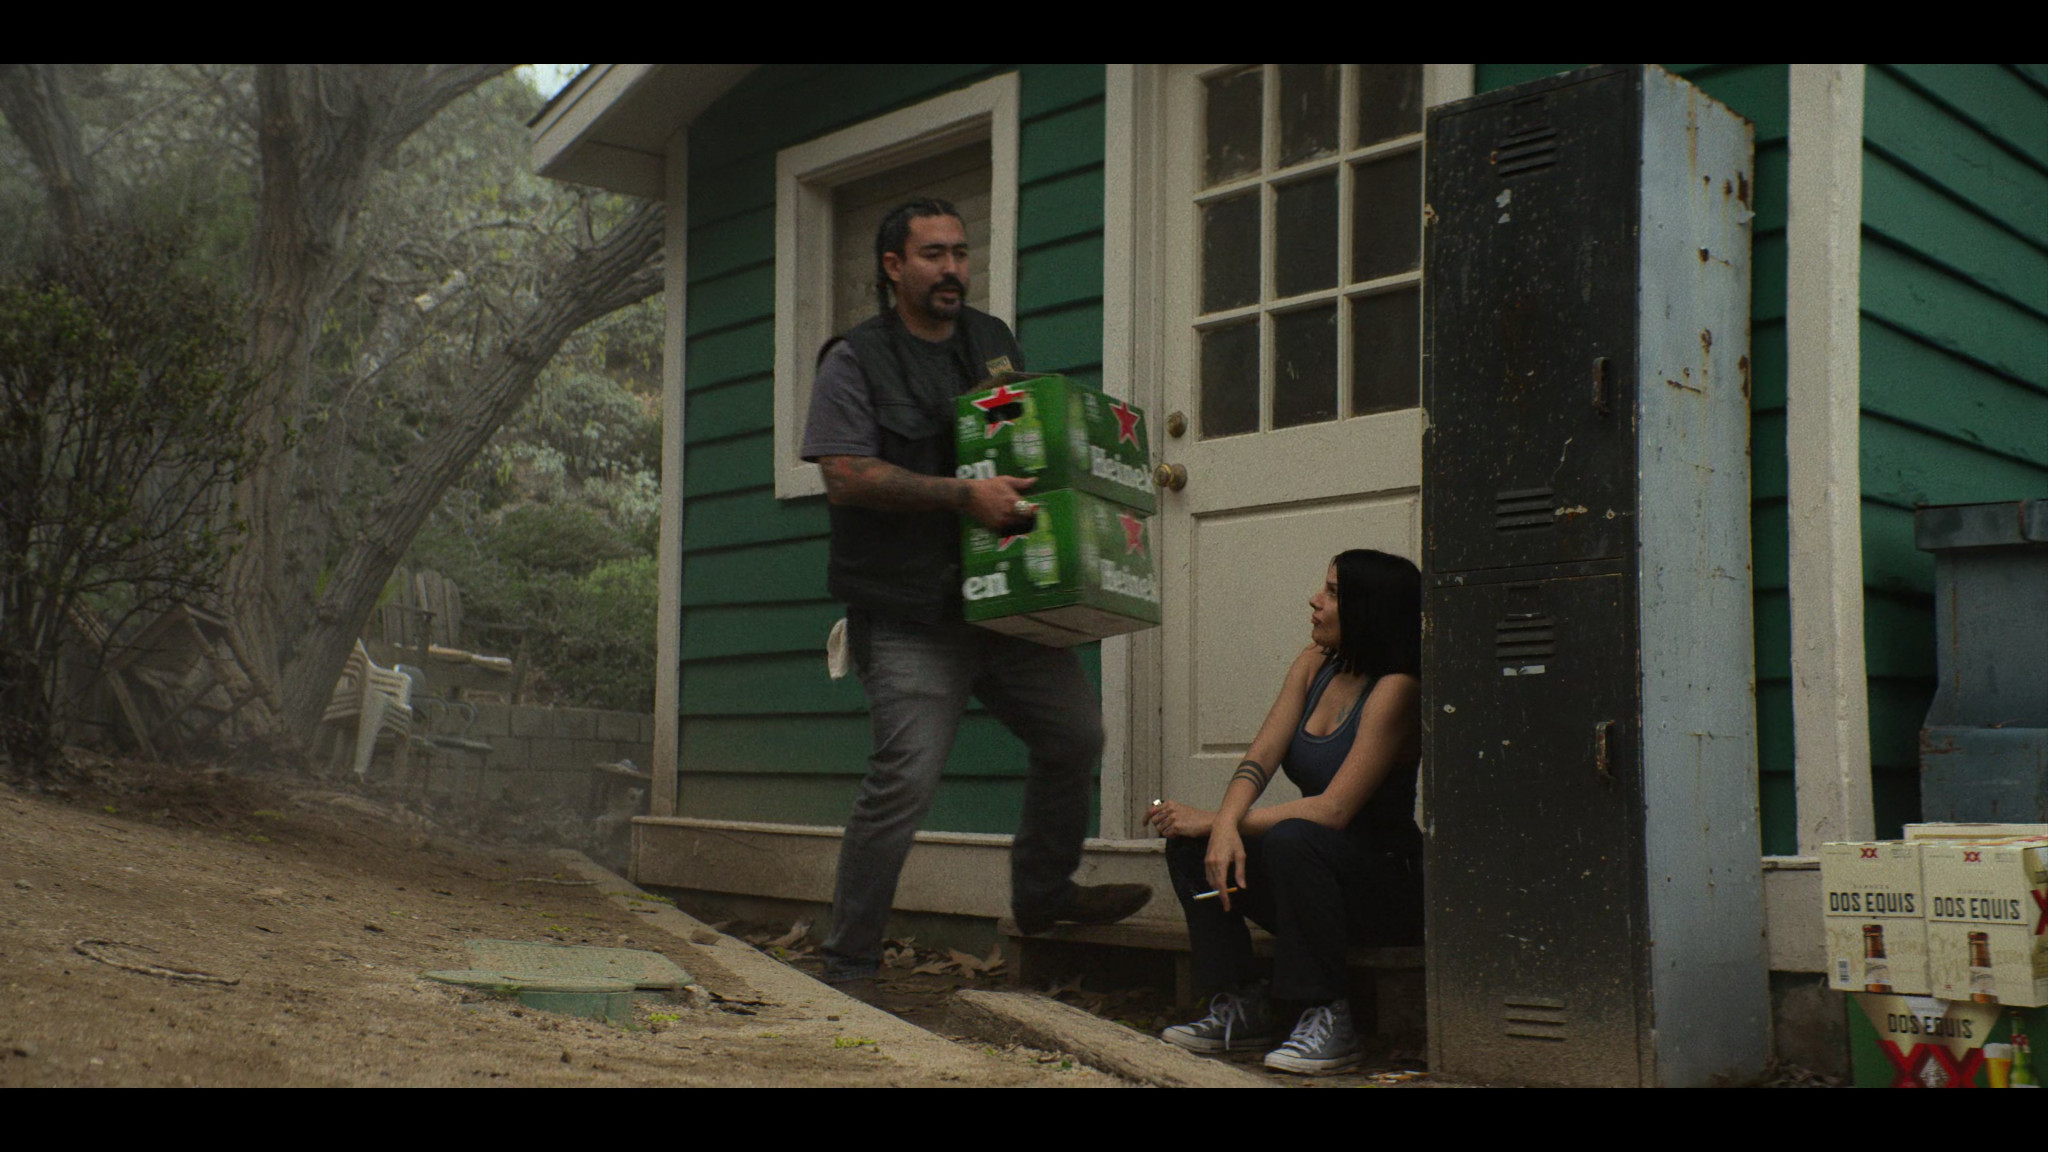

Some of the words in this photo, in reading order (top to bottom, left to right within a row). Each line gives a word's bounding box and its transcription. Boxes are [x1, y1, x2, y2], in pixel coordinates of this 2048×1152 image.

[1860, 848, 1879, 859] XX
[1963, 851, 1981, 863] XX
[1829, 892, 1861, 912] DOS
[1866, 892, 1915, 914] EQUIS
[1934, 896, 1965, 917] DOS
[1970, 898, 2020, 920] EQUIS
[1887, 1013, 1919, 1035] DOS
[1924, 1016, 1973, 1039] EQUIS
